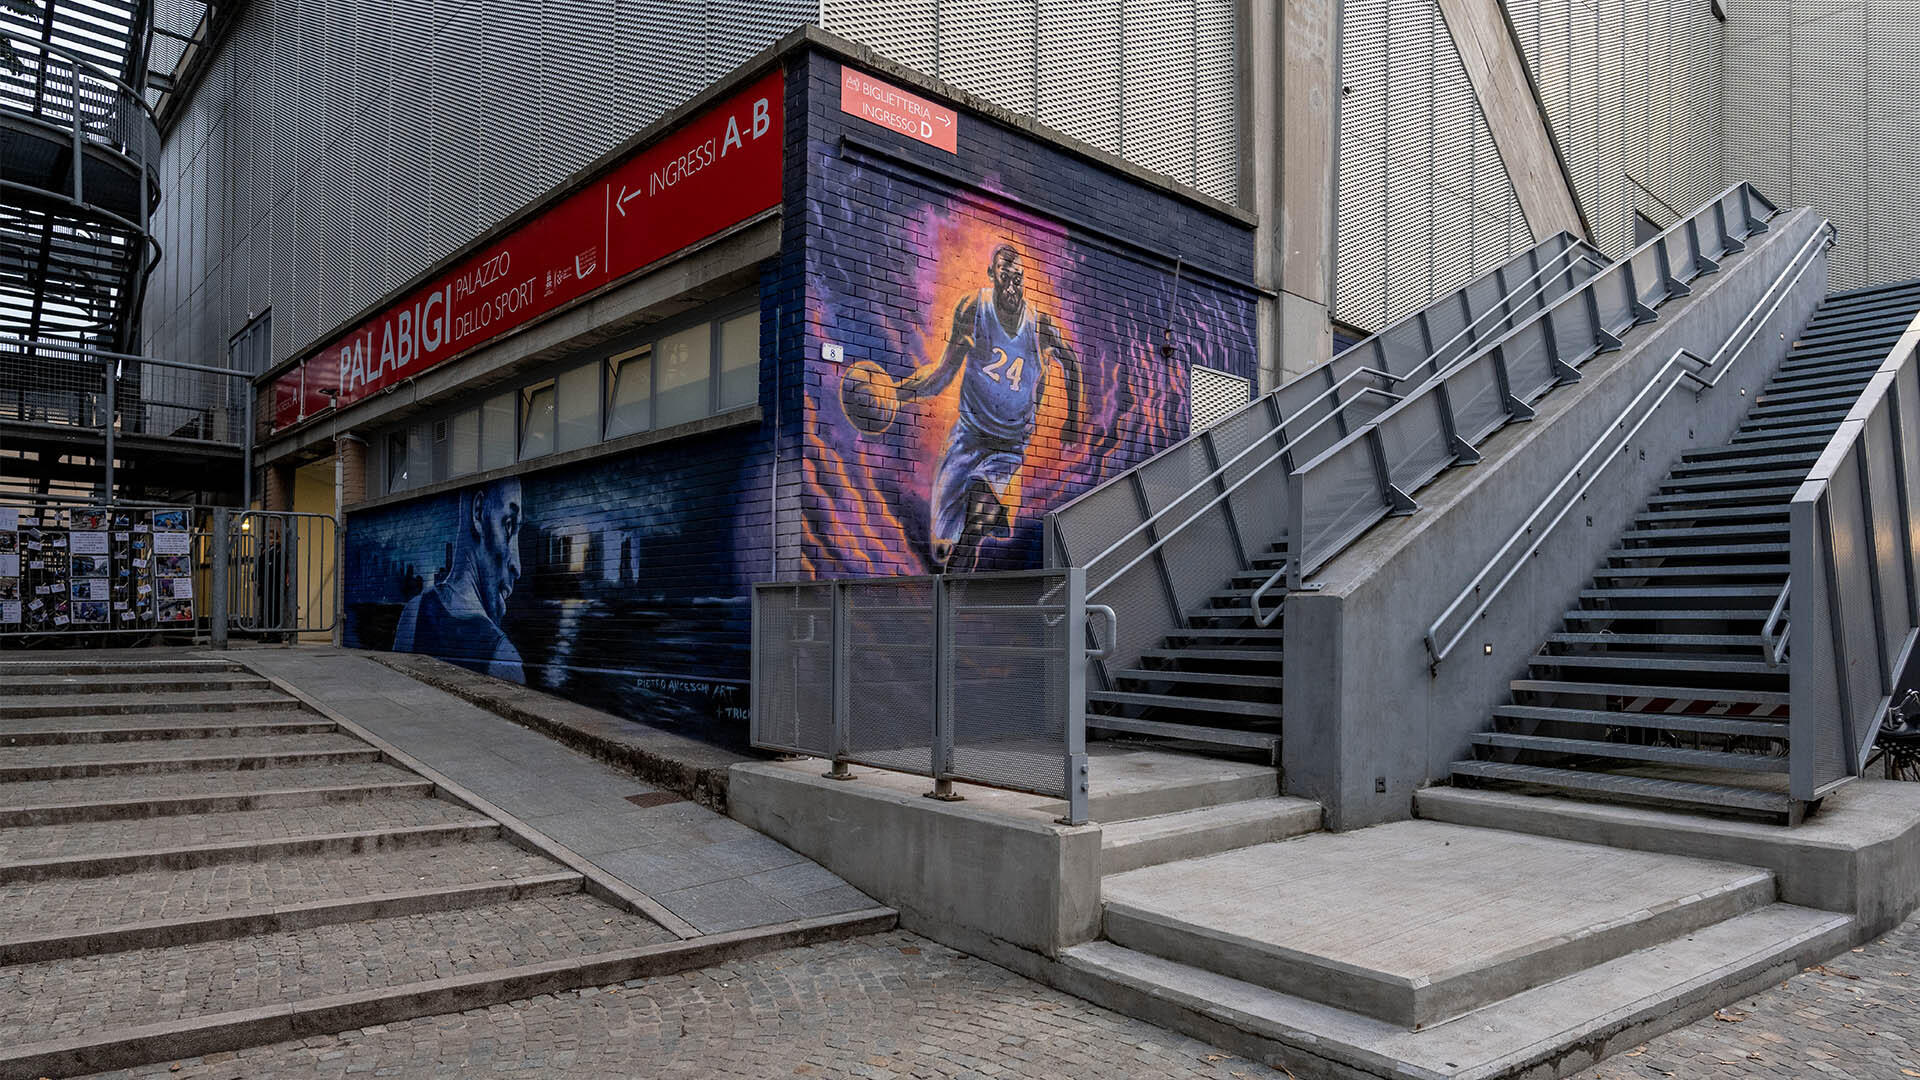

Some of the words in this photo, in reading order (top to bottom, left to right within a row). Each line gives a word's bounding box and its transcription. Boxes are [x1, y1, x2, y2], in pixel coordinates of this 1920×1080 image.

[862, 81, 931, 121] BIGLIETTERIA
[862, 102, 918, 134] INGRESSO
[920, 120, 933, 139] D
[650, 137, 716, 198] INGRESSI
[721, 97, 770, 158] A-B
[456, 250, 511, 302] PALAZZO
[455, 301, 492, 341] DELLO
[495, 276, 537, 321] SPORT
[339, 283, 452, 397] PALABIGI
[830, 348, 836, 359] 8
[982, 345, 1025, 392] 24
[636, 678, 666, 690] PIETRO
